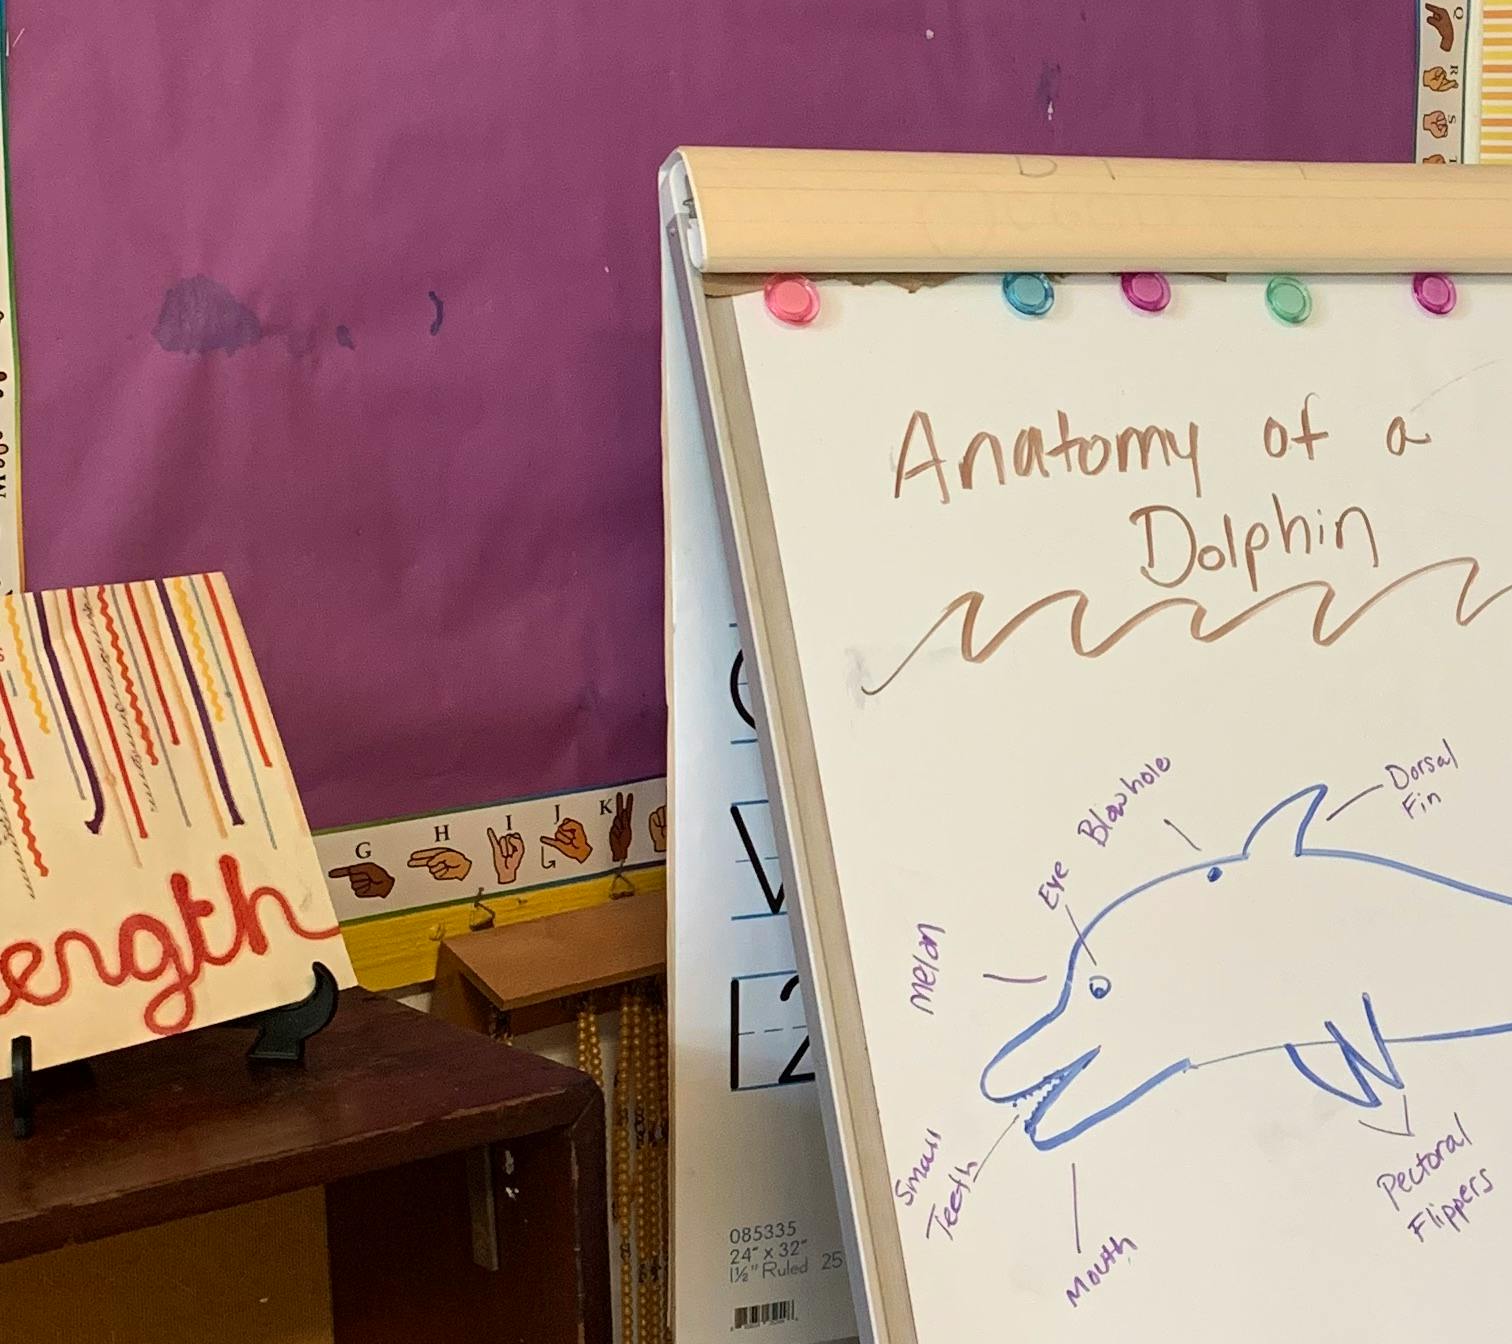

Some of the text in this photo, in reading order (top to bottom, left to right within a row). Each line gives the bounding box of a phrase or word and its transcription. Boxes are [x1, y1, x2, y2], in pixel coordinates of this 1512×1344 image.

[894, 392, 1432, 504] Anatomy of a
[1130, 494, 1378, 592] Dolphin
[1384, 738, 1459, 791] Dorsal
[354, 799, 613, 861] G H I J K
[1401, 790, 1442, 819] Fin
[1038, 860, 1069, 910] Eye
[0, 854, 340, 1036] ength
[1377, 1112, 1473, 1212] Pectoral
[730, 1221, 796, 1244] 085335
[926, 1161, 978, 1241] Teeth
[1408, 1167, 1495, 1243] Flippers
[762, 1258, 808, 1279] Ruled
[822, 1251, 844, 1270] 25
[764, 1247, 773, 1260] x
[1066, 1236, 1138, 1308] Mouth
